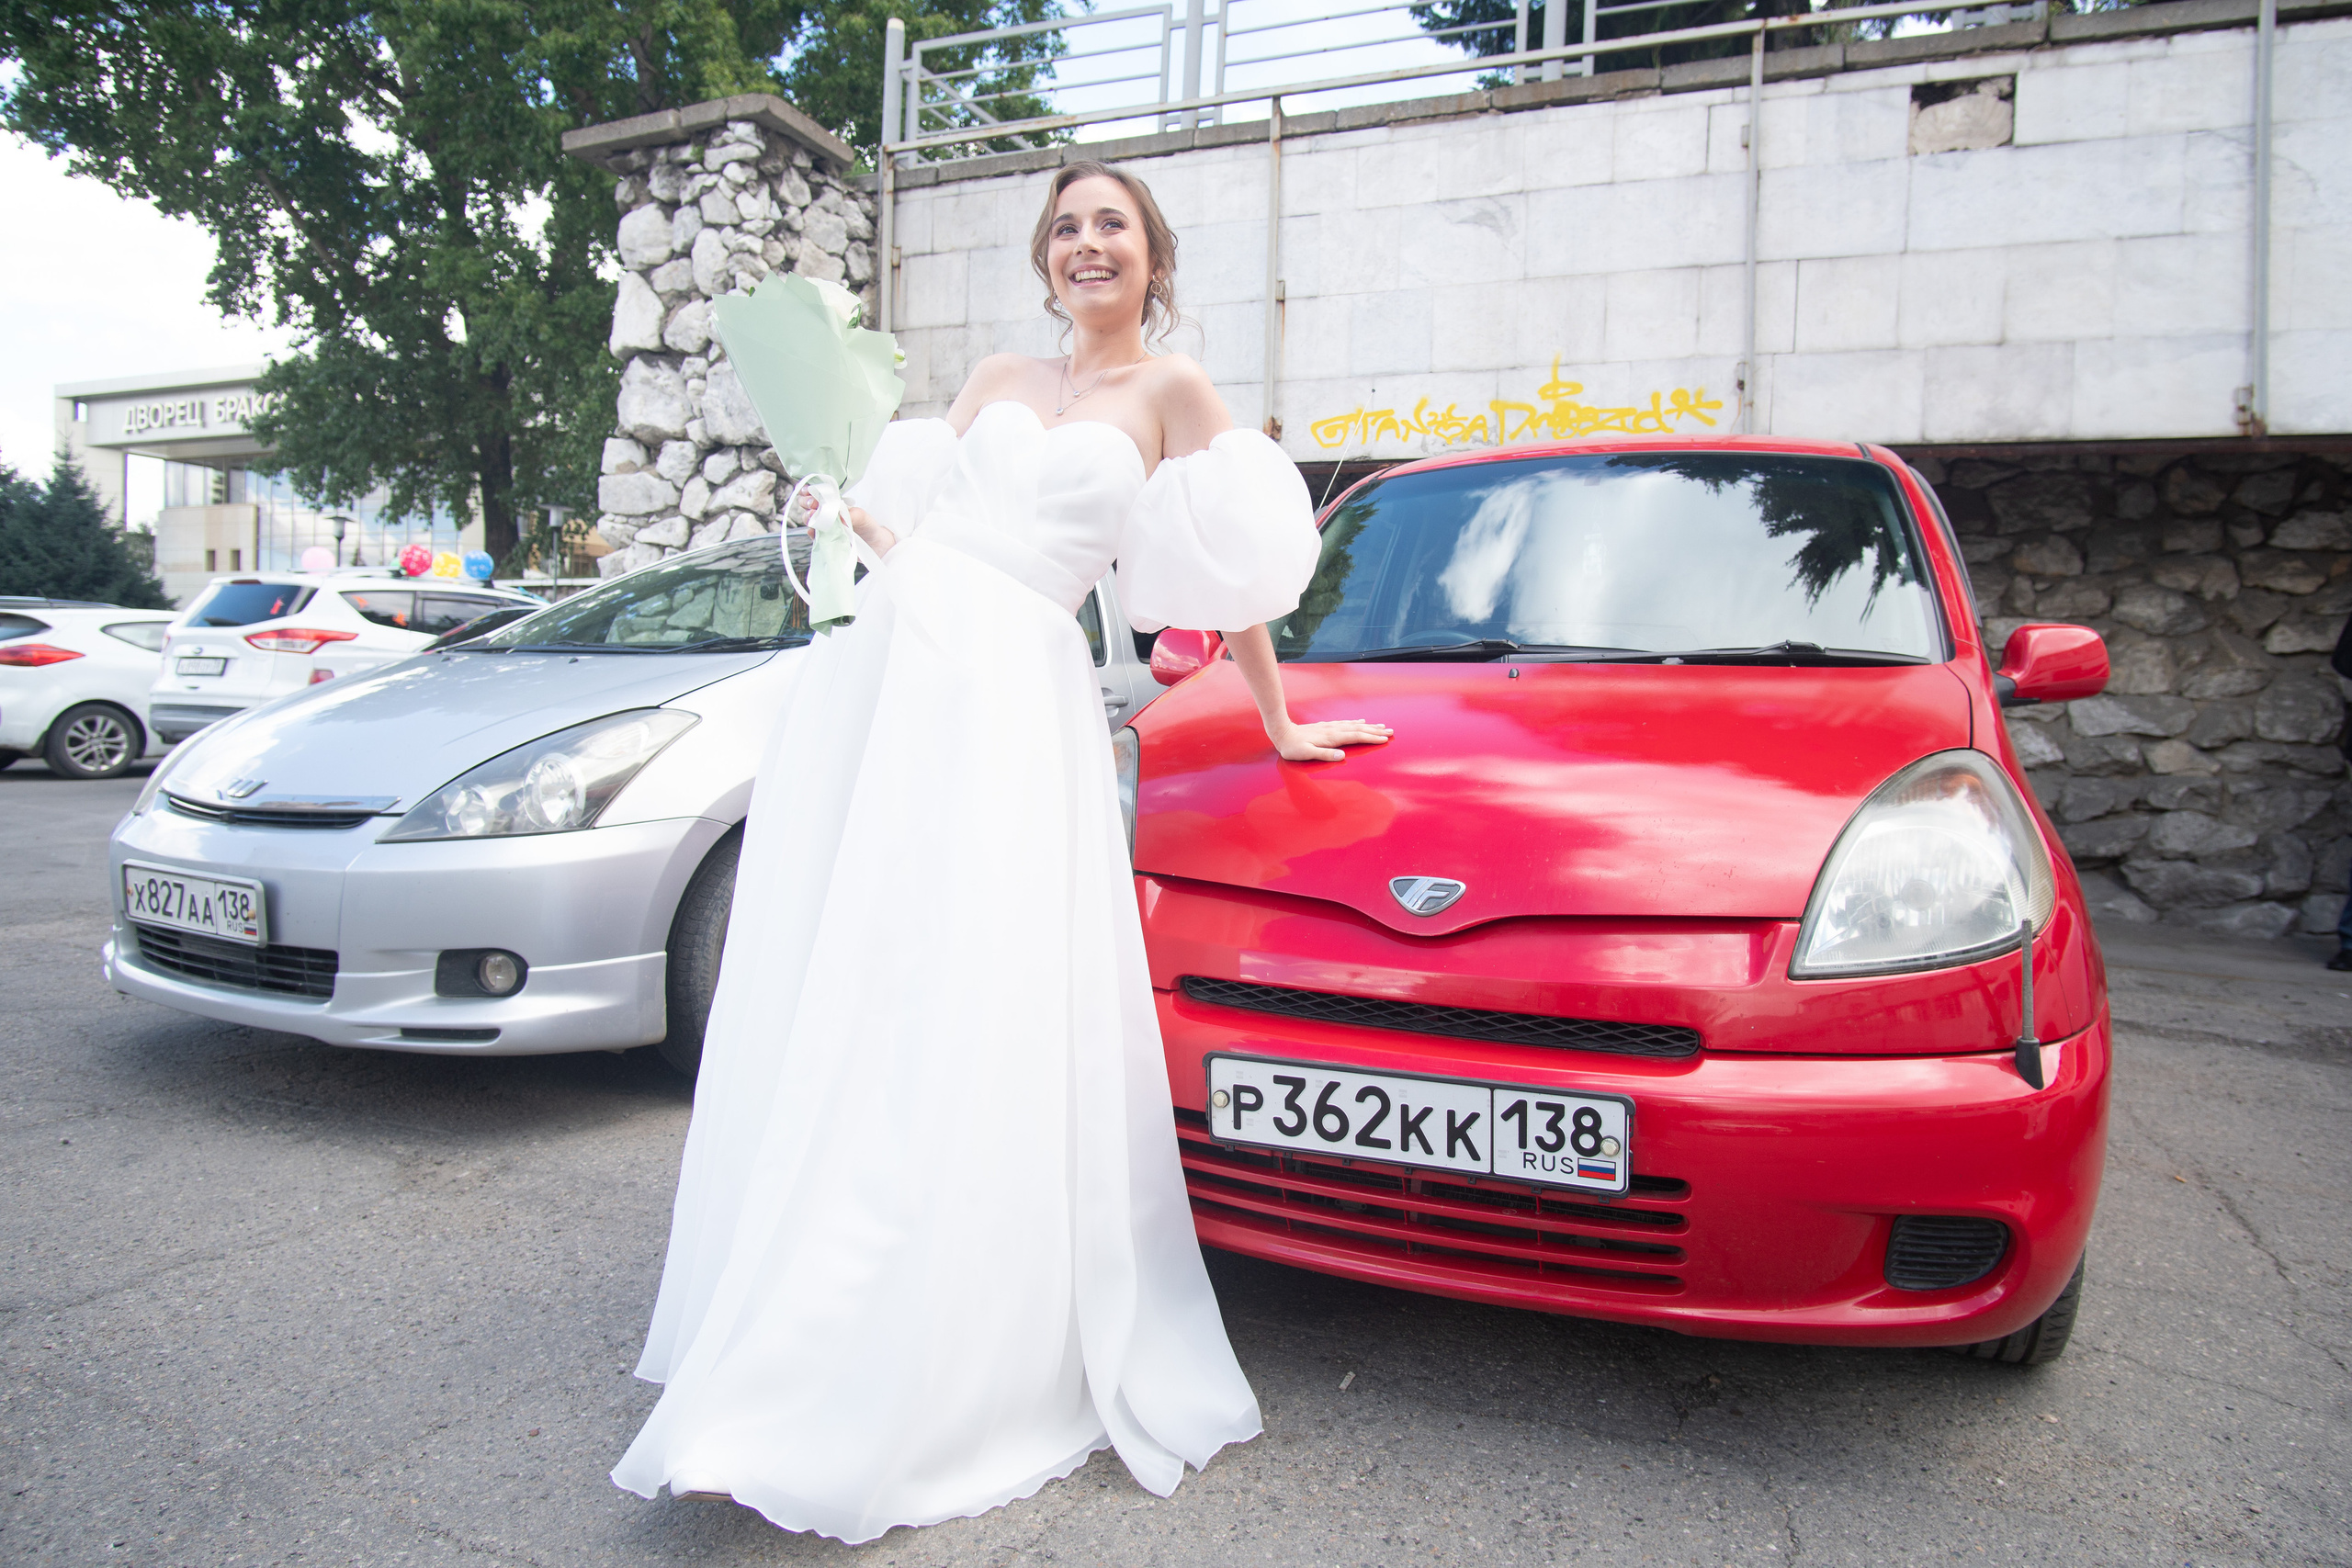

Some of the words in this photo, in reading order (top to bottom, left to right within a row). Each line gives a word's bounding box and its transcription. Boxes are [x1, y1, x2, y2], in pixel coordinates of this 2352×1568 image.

[123, 400, 205, 434] ДВОРЕЦ
[134, 878, 214, 926] Х827АА
[218, 889, 252, 922] 138
[227, 920, 243, 933] RUS
[1500, 1099, 1603, 1157] 138
[1522, 1151, 1574, 1174] RUS
